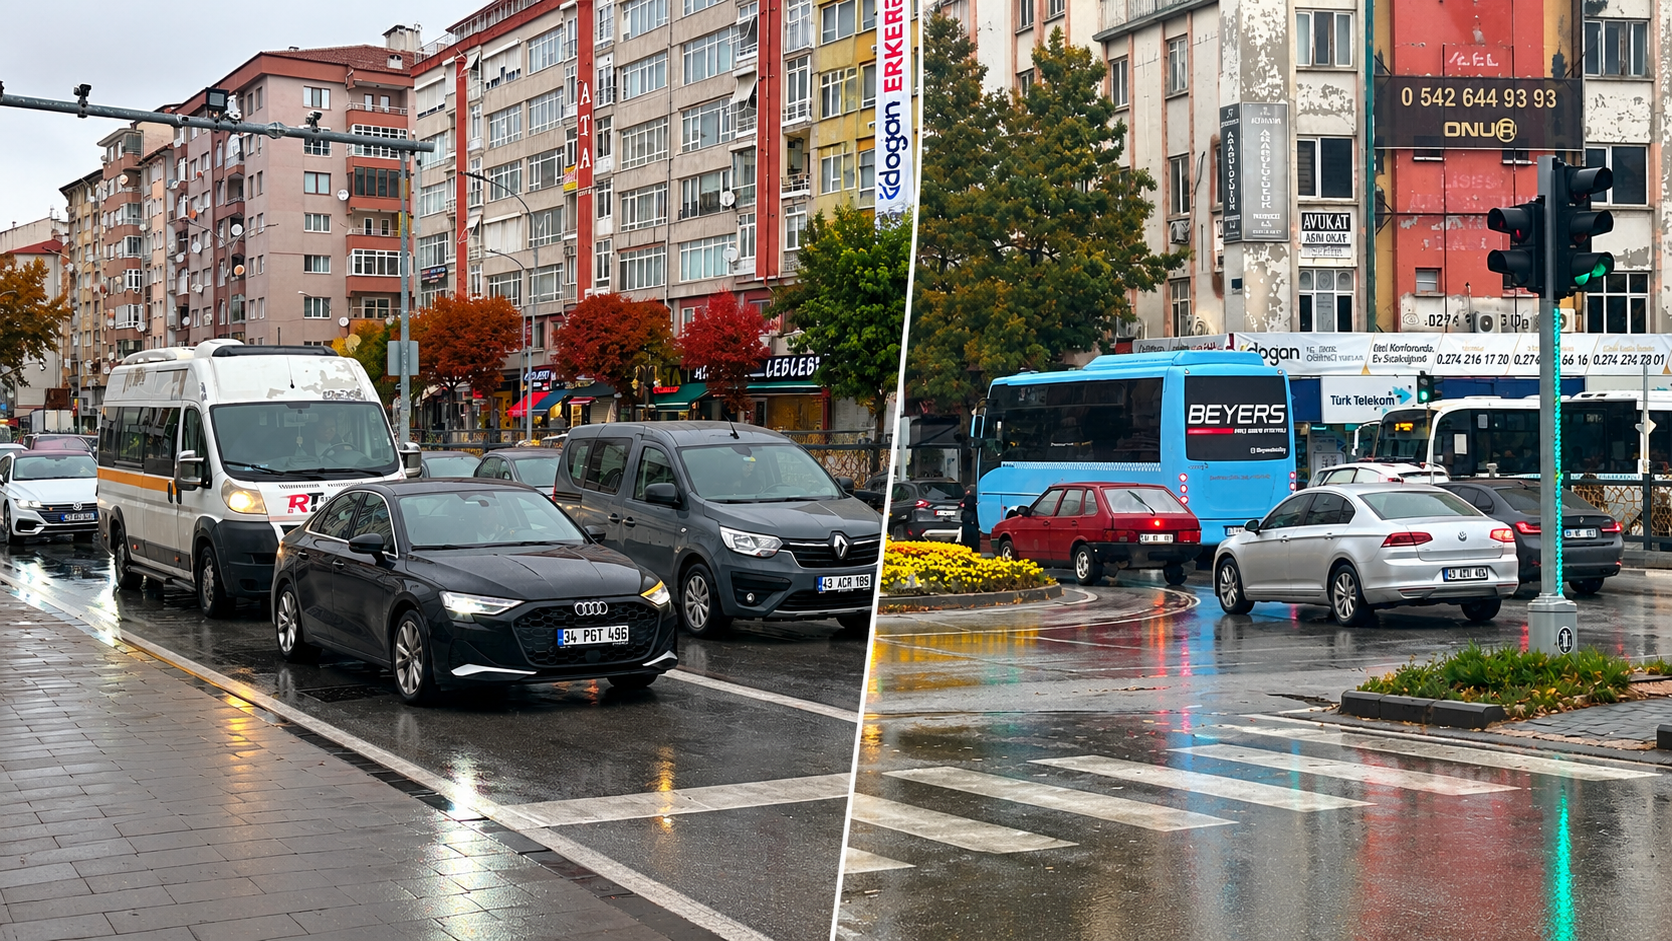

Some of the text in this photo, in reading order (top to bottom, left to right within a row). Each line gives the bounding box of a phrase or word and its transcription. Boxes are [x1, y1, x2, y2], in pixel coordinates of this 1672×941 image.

[1401, 87, 1557, 108] 0 542 644 93 93
[579, 82, 591, 169] ATA
[1303, 214, 1350, 230] AVUKAT
[1436, 353, 1462, 365] 0.274
[1463, 354, 1482, 365] 216
[1485, 354, 1496, 365] 17
[1497, 354, 1509, 365] 20
[1577, 354, 1588, 366] 16
[1330, 395, 1395, 406] Türk Telekom
[1187, 404, 1286, 424] BEYERS
[564, 627, 627, 643] 34 PGT 496
